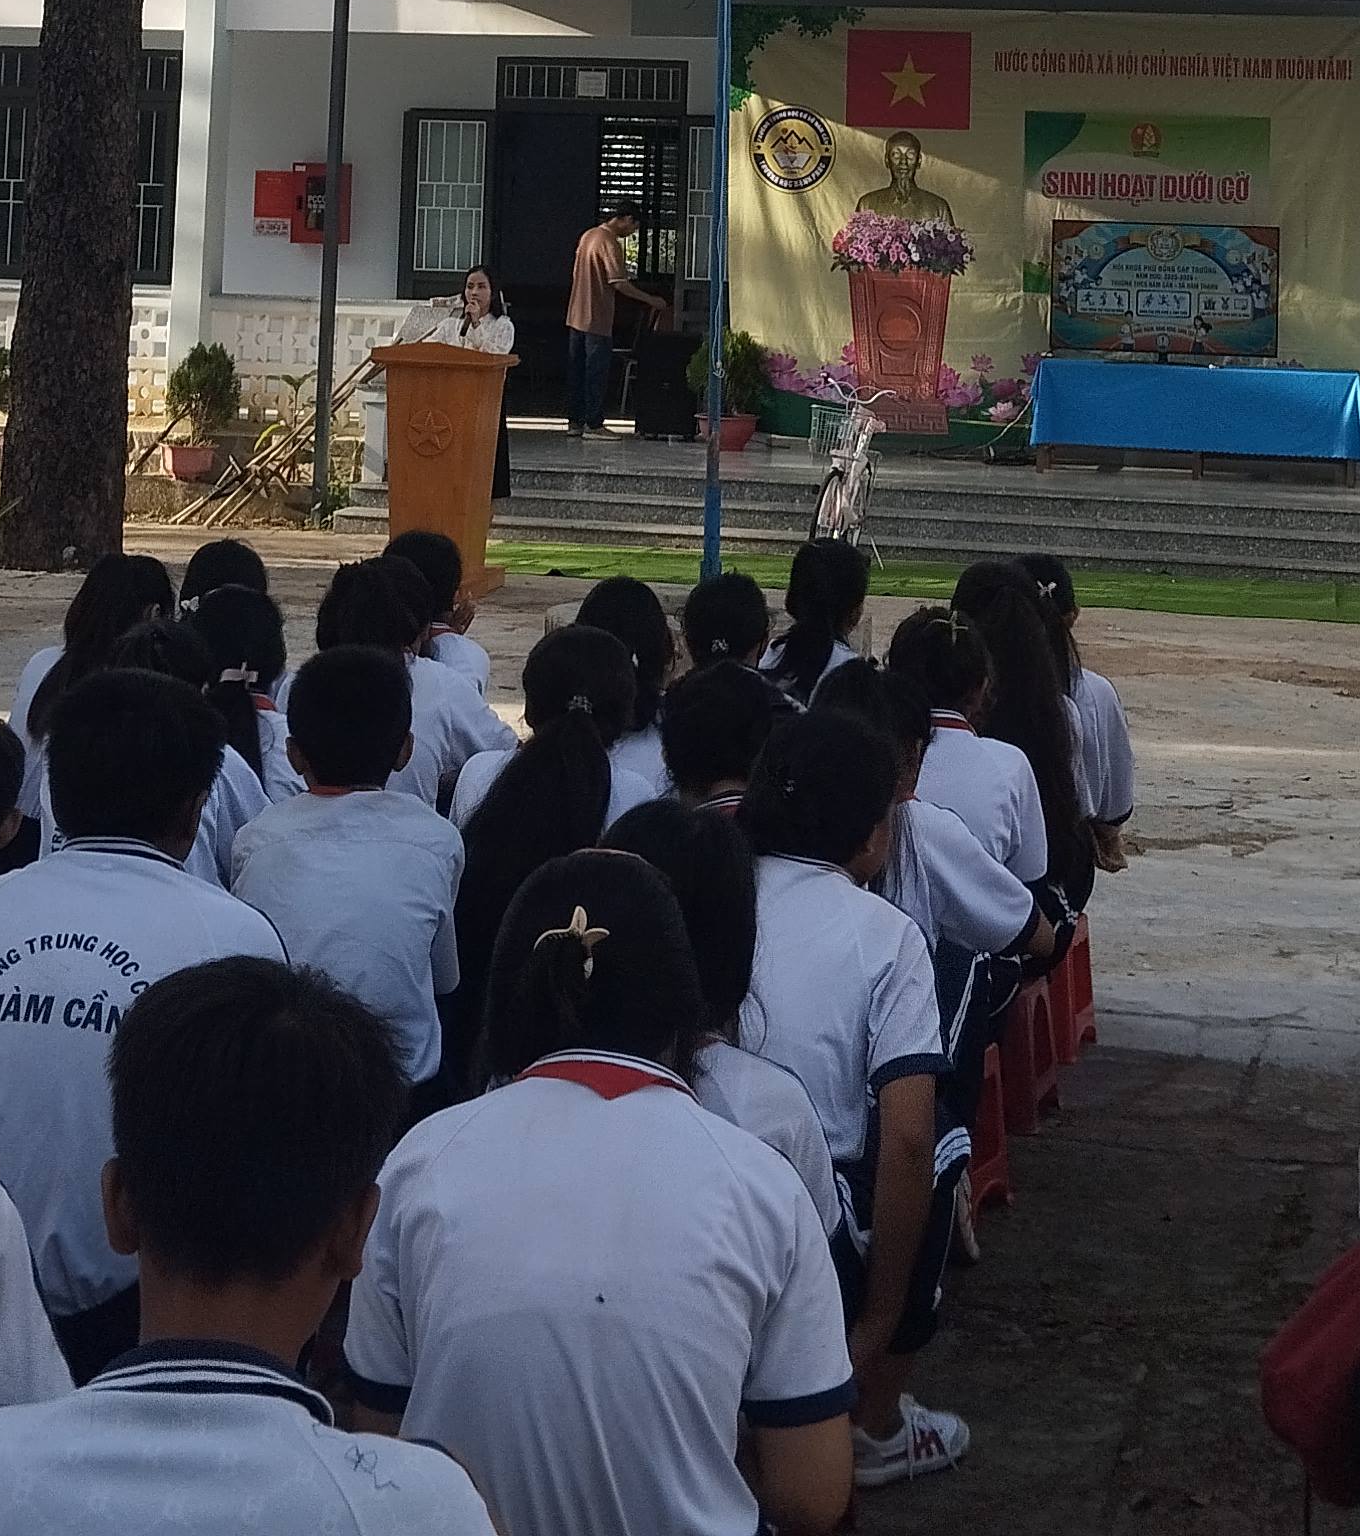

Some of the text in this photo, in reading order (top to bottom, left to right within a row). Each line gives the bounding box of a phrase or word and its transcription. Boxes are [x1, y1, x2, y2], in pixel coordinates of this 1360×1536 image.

[994, 48, 1028, 73] NƯỚC
[1031, 48, 1066, 77] CỘNG
[1097, 50, 1113, 74] XÃ
[1117, 50, 1138, 80] HỘI
[1141, 49, 1167, 76] CHỦ
[1169, 52, 1209, 77] NGHĨA
[1212, 53, 1239, 82] VIỆT
[1242, 57, 1272, 79] NAM
[1042, 170, 1251, 206] SINH HOẠT DƯỚI CỜ
[24, 933, 99, 955] TRUNG
[99, 941, 141, 977] HỌC
